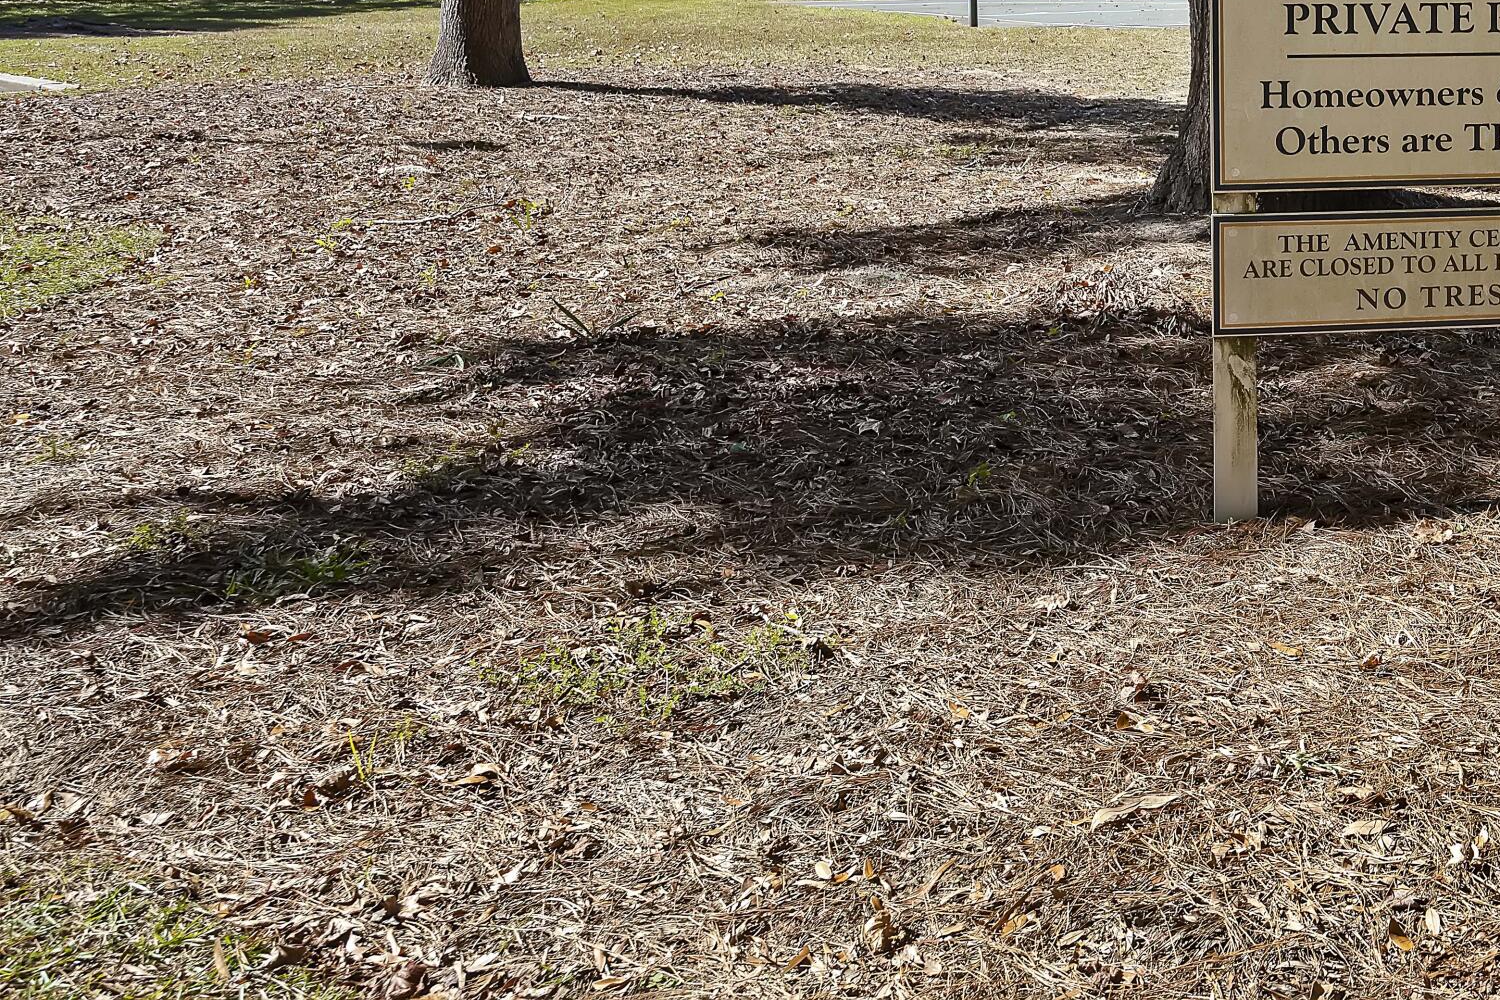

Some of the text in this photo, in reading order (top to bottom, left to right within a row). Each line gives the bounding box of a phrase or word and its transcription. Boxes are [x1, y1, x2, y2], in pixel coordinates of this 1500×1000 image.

[1283, 2, 1475, 36] PRIVATE
[1260, 80, 1484, 109] Homeowners
[1275, 125, 1390, 156] Others
[1402, 132, 1453, 154] are
[1277, 233, 1331, 254] THE
[1343, 230, 1462, 252] AMENITY
[1242, 260, 1293, 279] ARE
[1299, 256, 1395, 278] CLOSED
[1400, 254, 1437, 275] TO
[1443, 253, 1488, 273] ALL
[1356, 286, 1407, 311] NO
